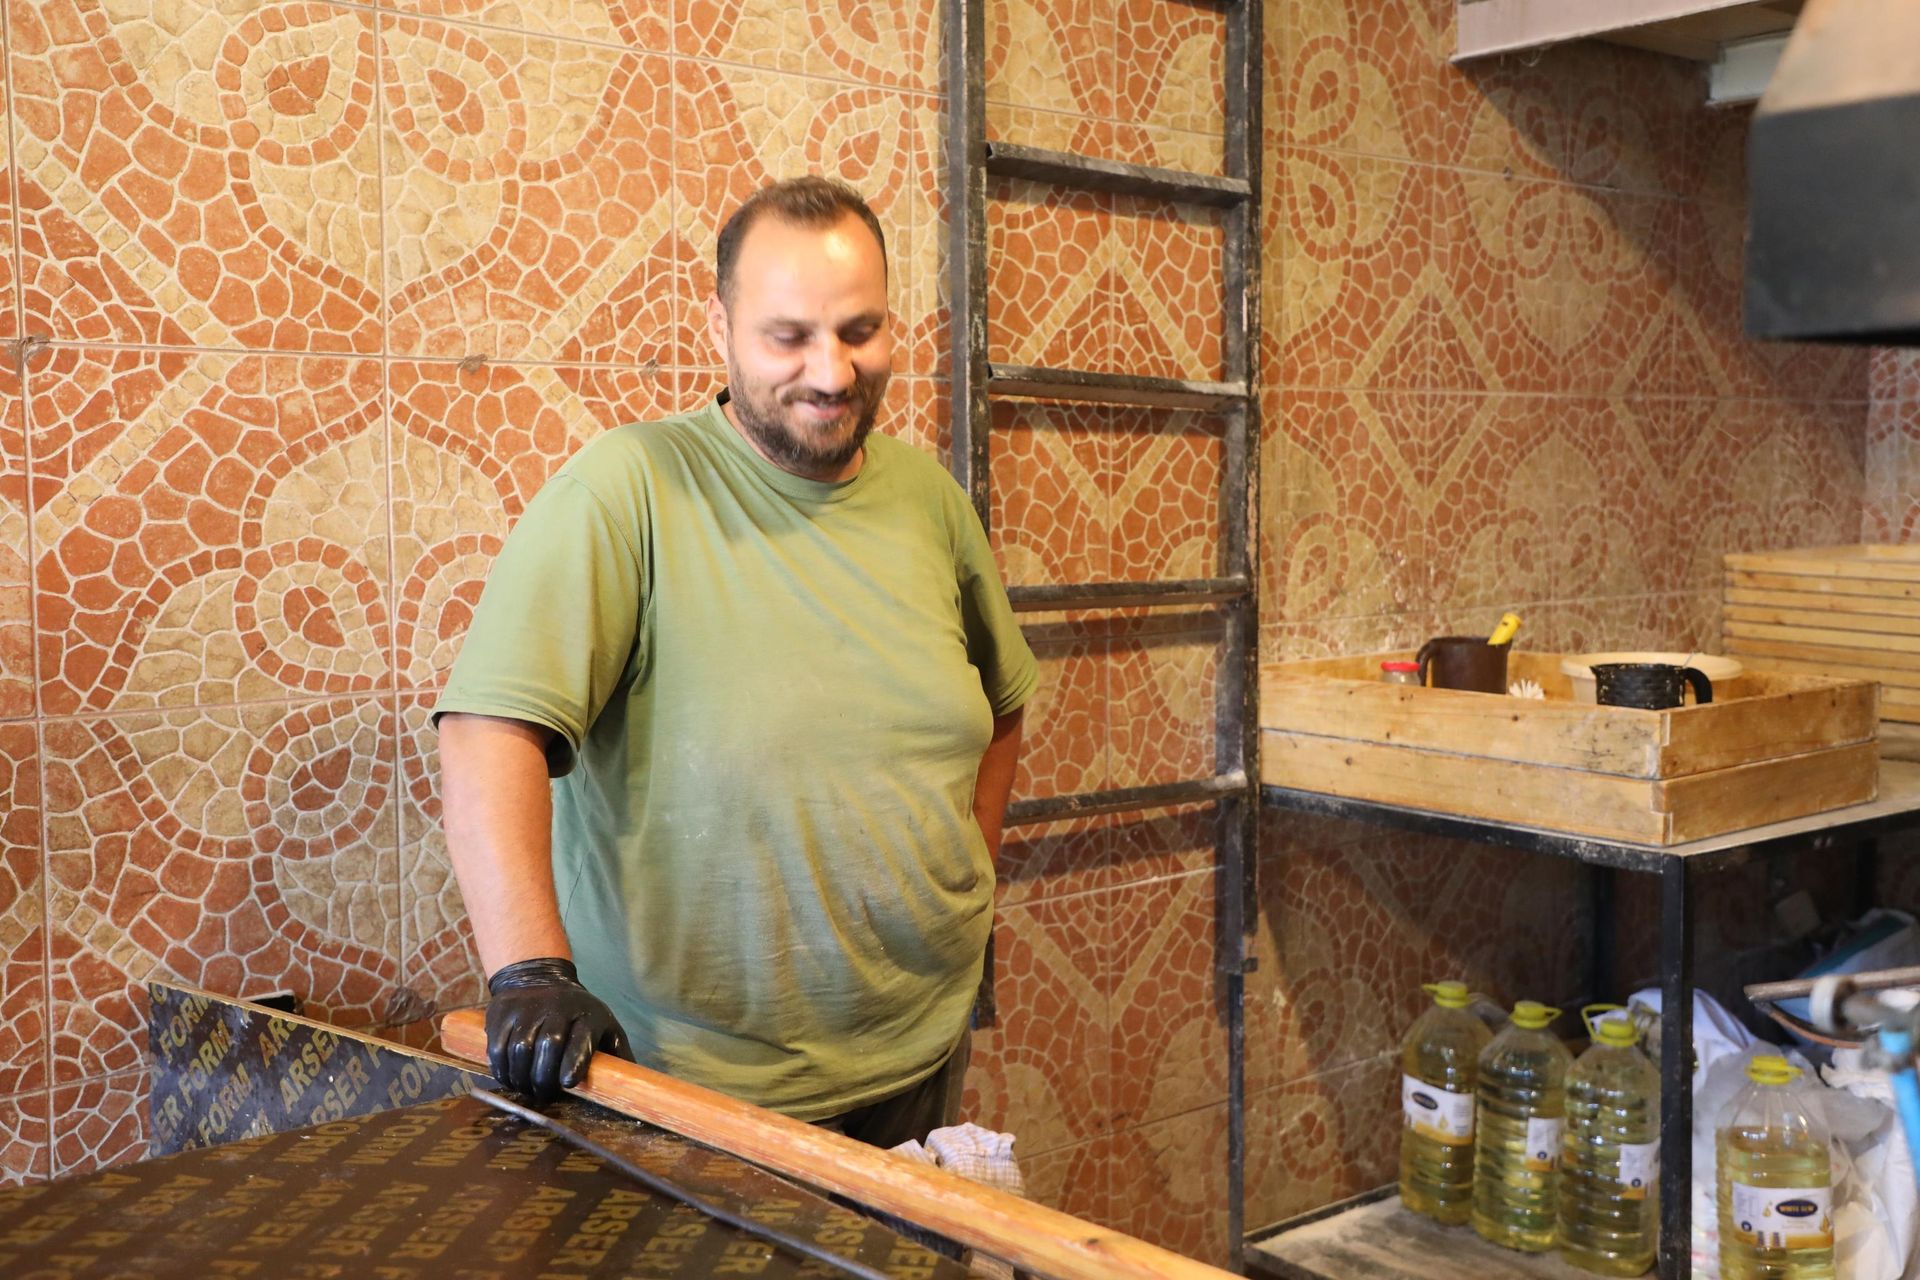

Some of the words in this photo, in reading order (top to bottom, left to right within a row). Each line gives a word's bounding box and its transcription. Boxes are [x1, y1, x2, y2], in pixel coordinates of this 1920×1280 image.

[178, 1019, 232, 1107] FORM
[198, 1062, 253, 1147] FORM
[343, 1115, 441, 1165] FORM
[412, 1117, 500, 1167] ORM
[485, 1129, 560, 1170] ORM
[549, 1189, 650, 1267] ARSER
